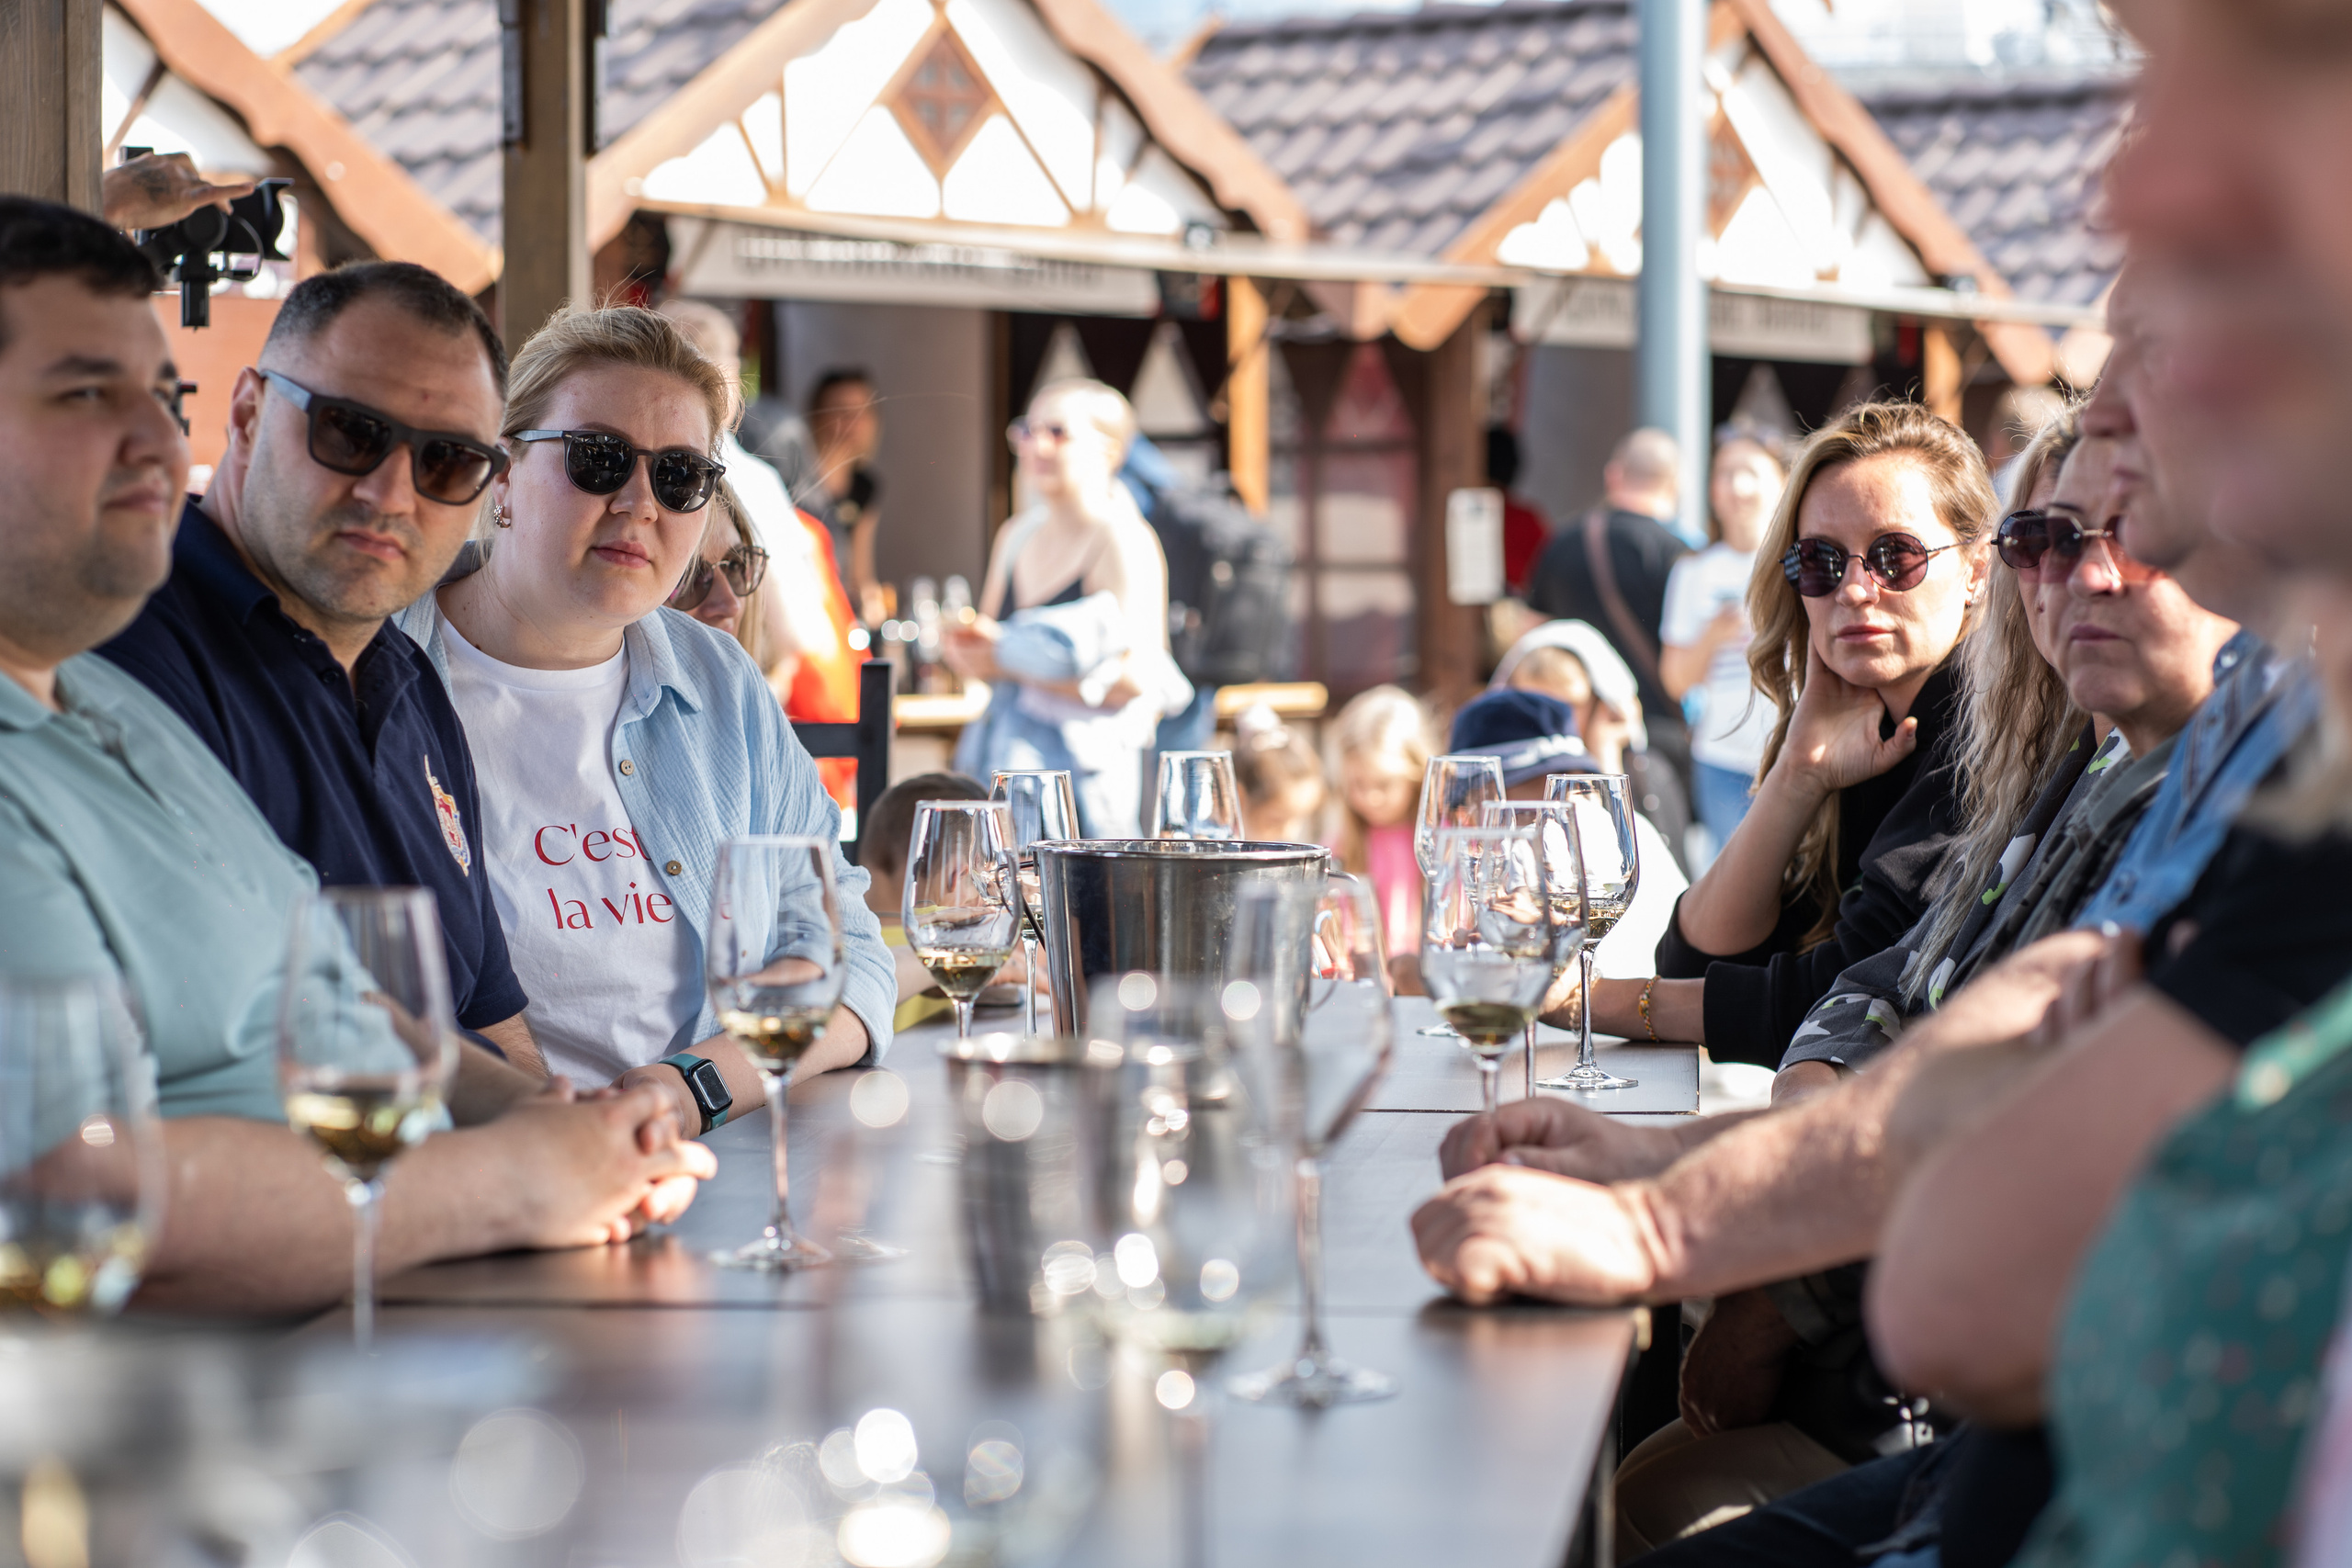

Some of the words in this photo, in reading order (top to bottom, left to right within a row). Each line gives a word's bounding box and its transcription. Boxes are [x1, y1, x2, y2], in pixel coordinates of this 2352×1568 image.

[534, 823, 651, 865] C'est
[547, 887, 594, 930] la
[601, 881, 675, 926] vie
